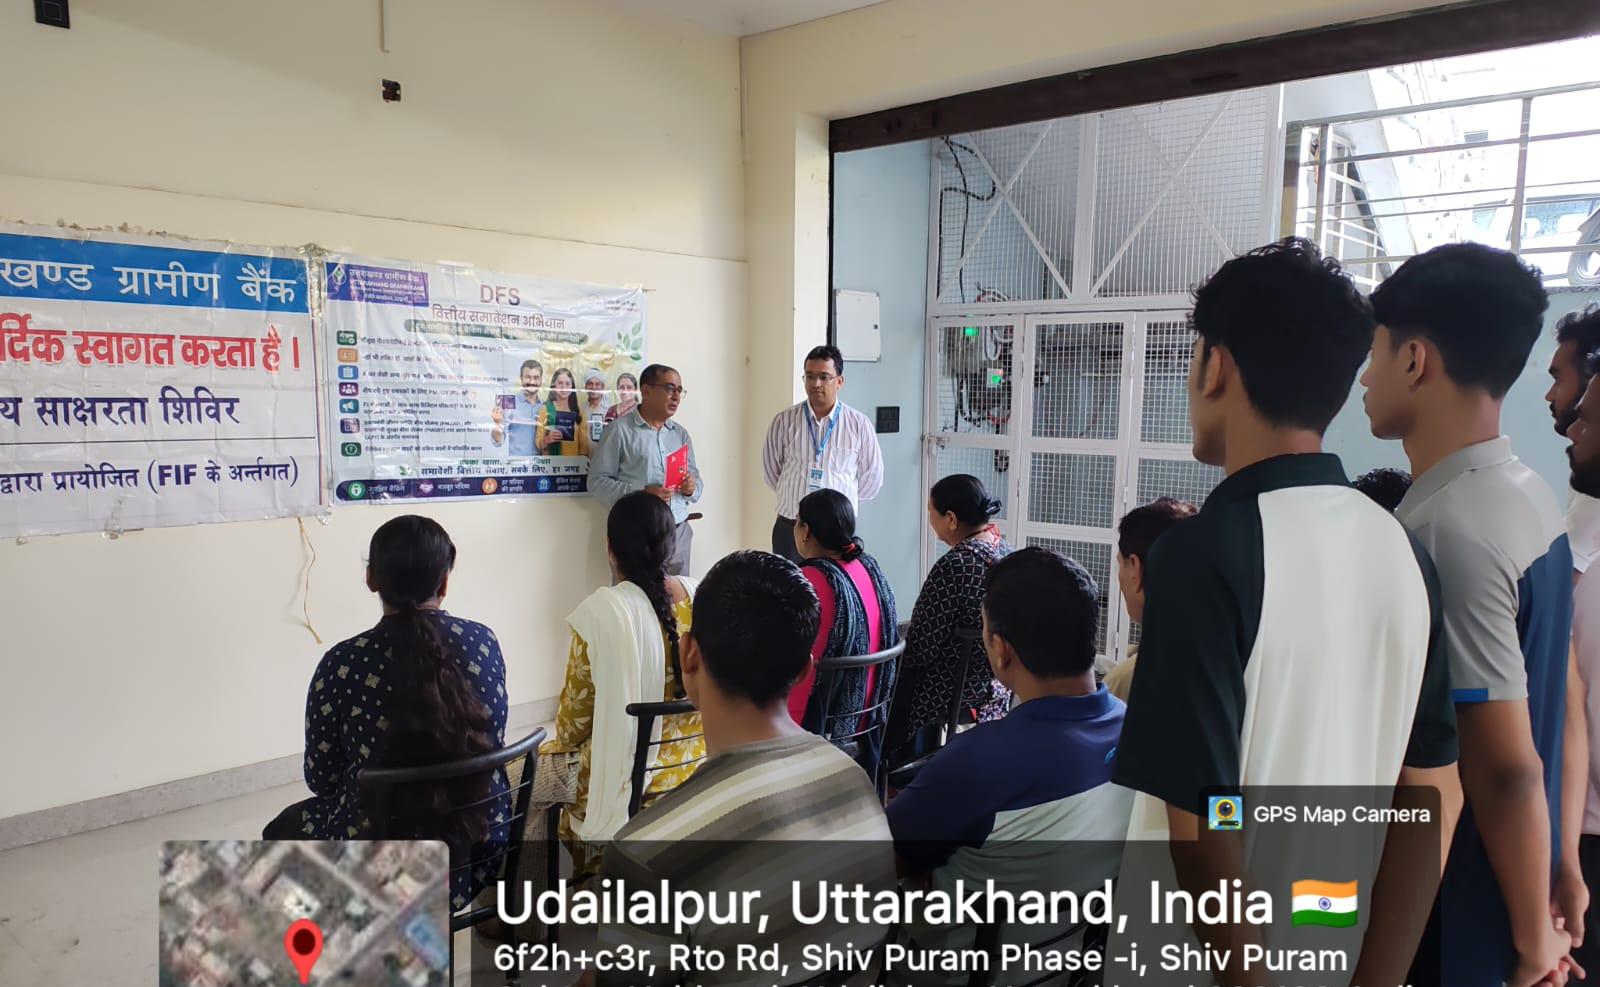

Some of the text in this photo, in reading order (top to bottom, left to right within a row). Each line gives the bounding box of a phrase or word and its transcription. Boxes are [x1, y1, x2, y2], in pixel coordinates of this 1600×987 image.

[112, 261, 221, 300] ग्रामीण
[236, 262, 297, 304] बैंक
[480, 283, 521, 306] DFS
[72, 330, 175, 366] स्वागत
[180, 334, 256, 368] करता
[260, 323, 281, 372] है
[34, 397, 148, 426] साक्षरता
[159, 386, 240, 425] शिविर
[0, 472, 43, 494] द्वारा
[51, 462, 139, 491] प्रायोजित
[147, 459, 197, 494] (FIF
[205, 459, 221, 482] के
